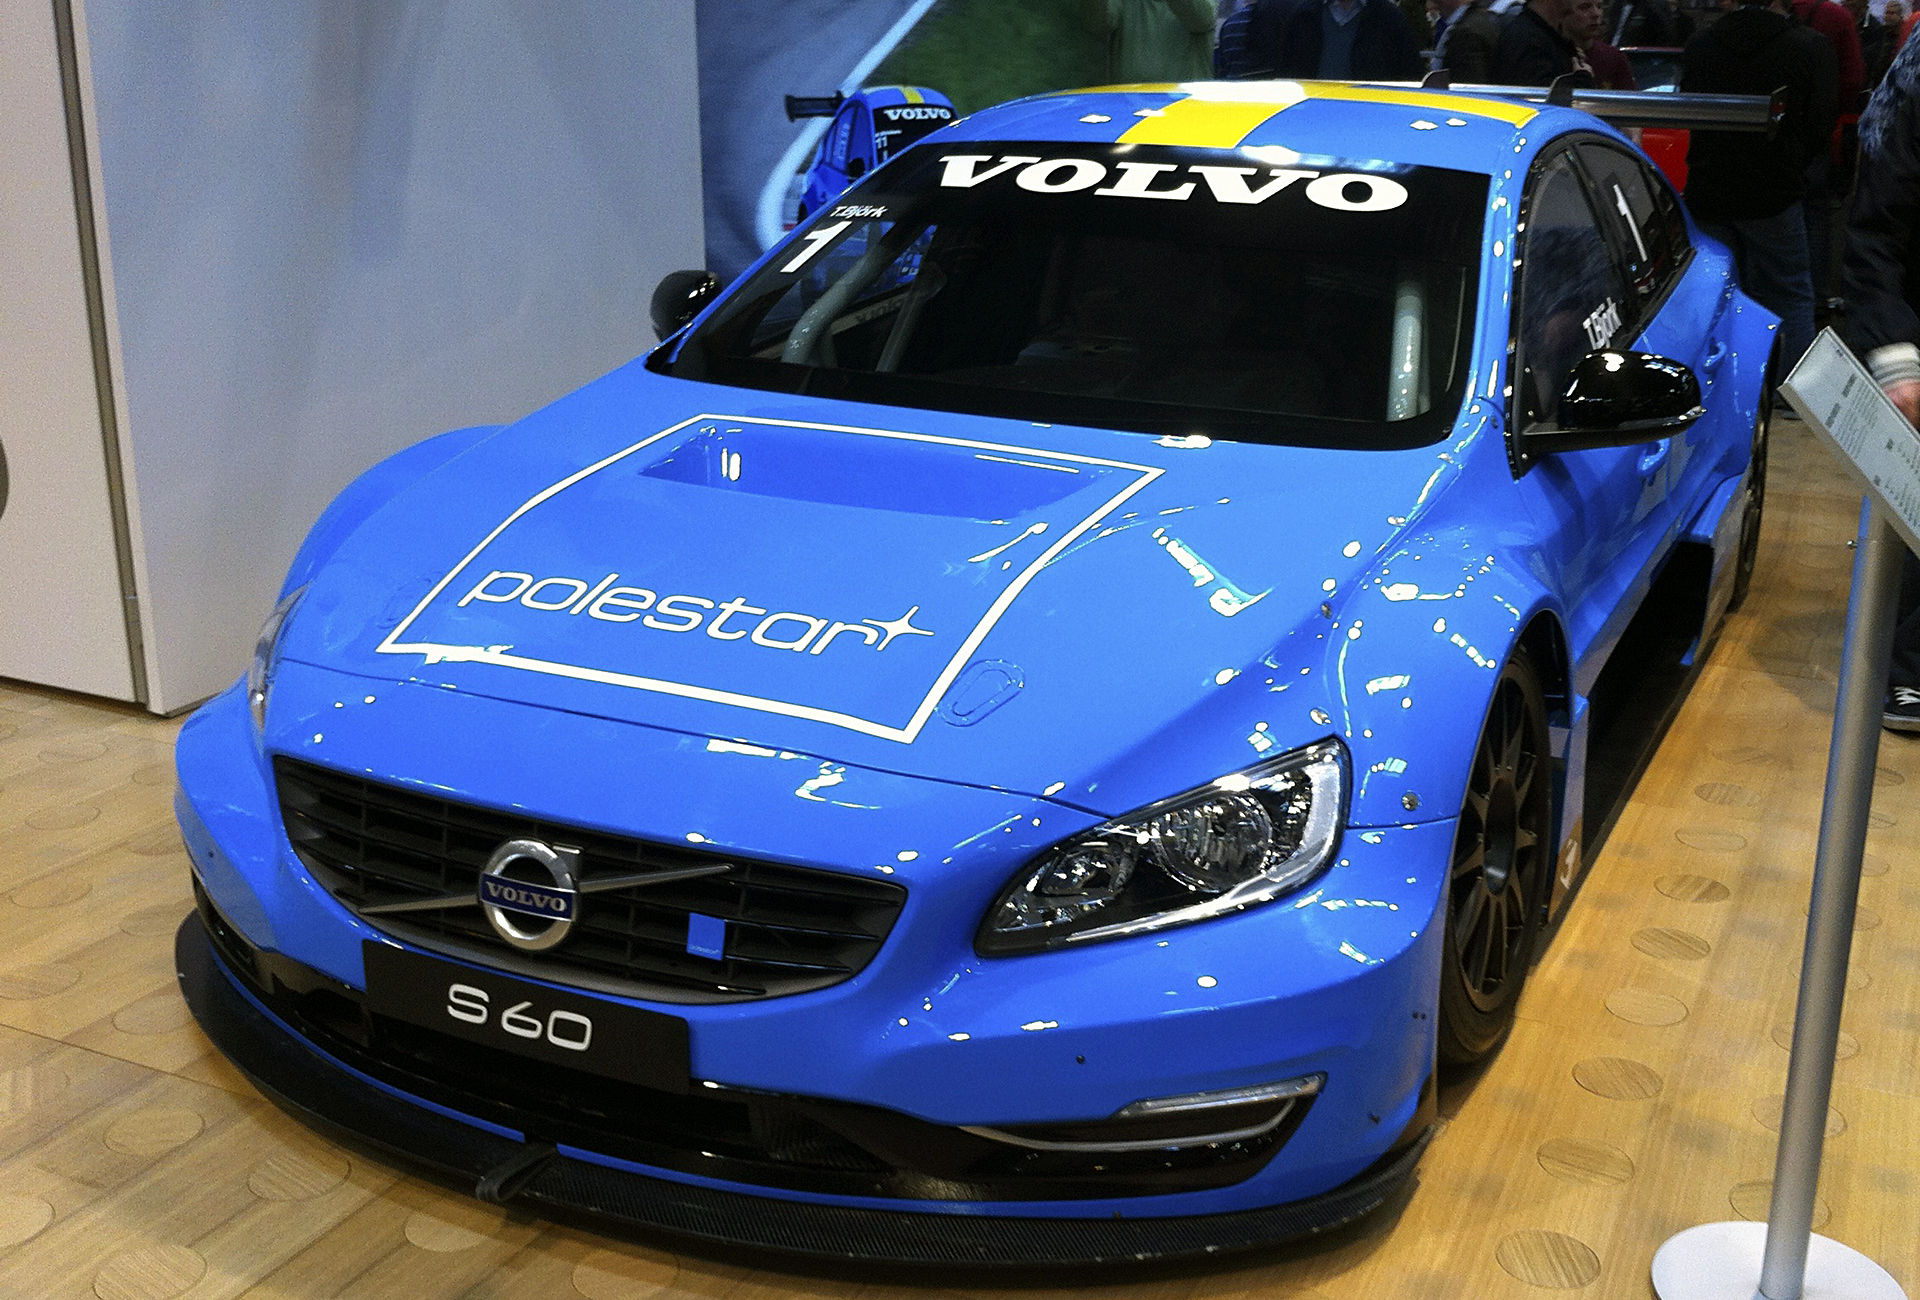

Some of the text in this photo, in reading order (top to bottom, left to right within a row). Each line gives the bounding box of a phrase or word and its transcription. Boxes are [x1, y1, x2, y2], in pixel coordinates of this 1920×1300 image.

[884, 108, 951, 120] VOLVO
[939, 155, 1408, 212] VOLVO
[780, 221, 852, 273] 1
[457, 570, 890, 656] polestar
[485, 881, 567, 912] VOLVO
